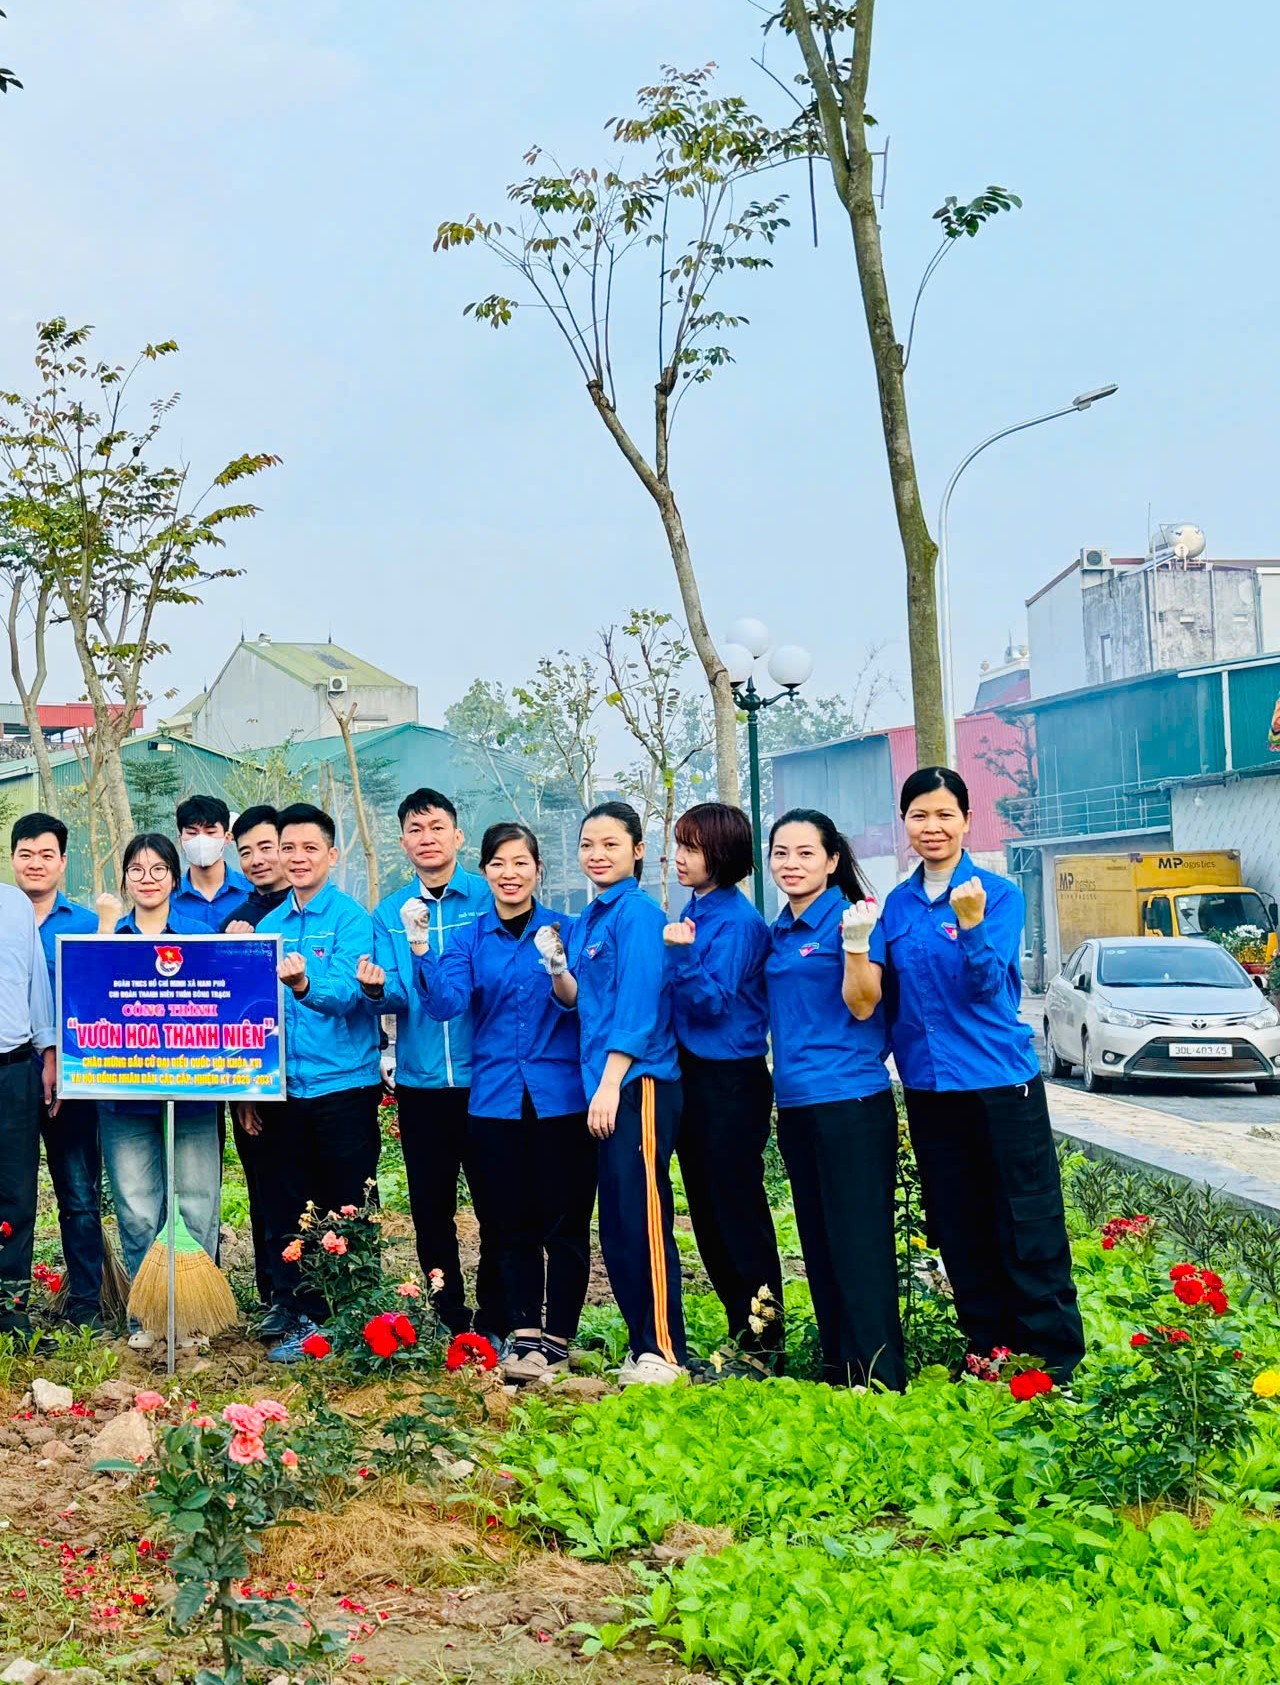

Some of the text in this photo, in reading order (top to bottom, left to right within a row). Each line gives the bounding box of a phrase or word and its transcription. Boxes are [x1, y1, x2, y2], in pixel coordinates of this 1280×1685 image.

[1158, 857, 1183, 869] MP
[1059, 872, 1074, 890] MP
[131, 980, 147, 988] TNCS
[170, 980, 186, 988] MINH
[197, 980, 211, 988] NAM
[122, 1000, 218, 1016] CÔNG TRÌNH
[125, 1024, 160, 1048] HOA
[163, 1024, 220, 1048] THANH
